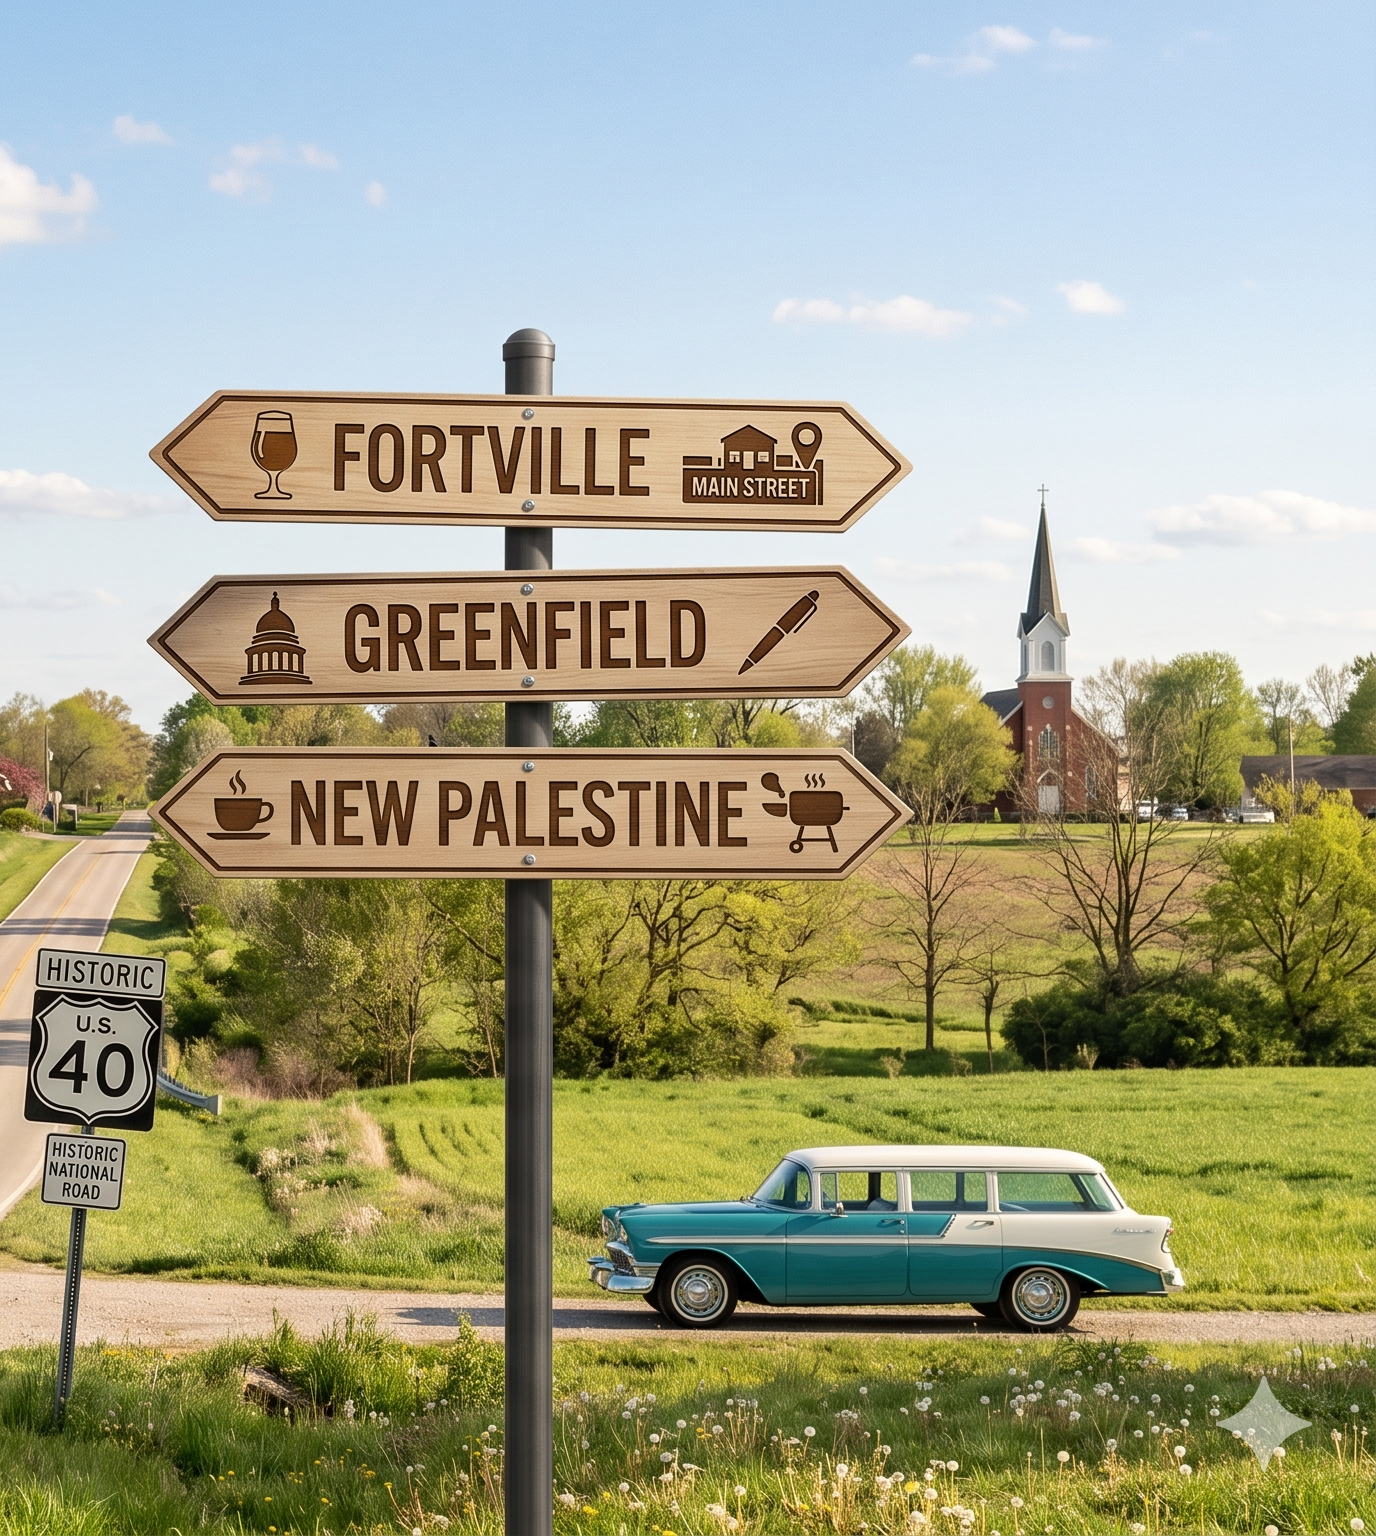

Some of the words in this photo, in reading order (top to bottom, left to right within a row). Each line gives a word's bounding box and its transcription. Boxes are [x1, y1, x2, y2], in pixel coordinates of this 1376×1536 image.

[333, 422, 651, 497] FORTVILLE
[692, 476, 738, 497] MAIN
[743, 477, 810, 498] STREET
[344, 599, 707, 674] GREENFIELD
[290, 779, 420, 847] NEW
[438, 780, 748, 848] PALESTINE
[47, 957, 155, 990] HISTORIC
[76, 1014, 117, 1035] U.S.
[48, 1039, 135, 1098] 40
[52, 1141, 119, 1163] HISTORIC
[48, 1160, 119, 1183] NATIONAL
[61, 1181, 101, 1200] ROAD
